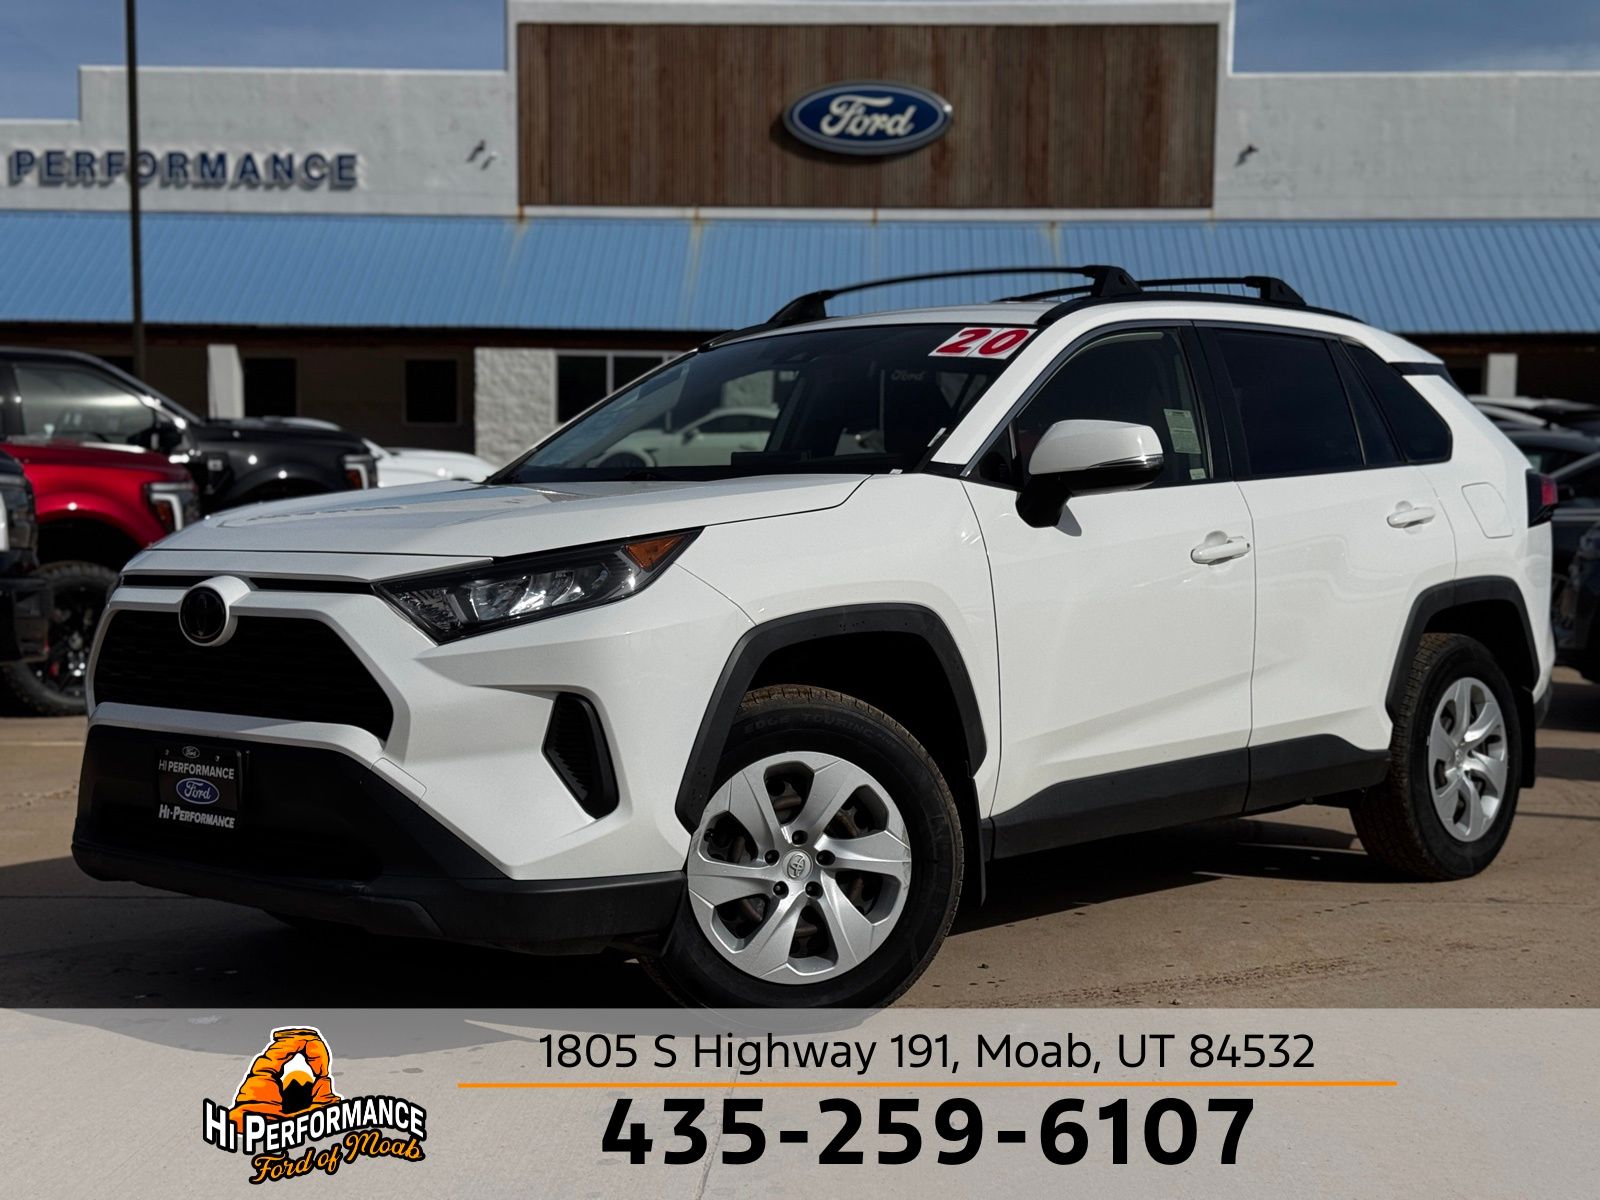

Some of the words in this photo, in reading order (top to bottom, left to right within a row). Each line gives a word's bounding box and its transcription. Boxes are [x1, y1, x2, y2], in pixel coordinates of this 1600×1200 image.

[820, 94, 917, 137] Ford
[11, 150, 358, 188] PERFORMANCE
[935, 328, 1030, 356] 20
[743, 714, 791, 734] EDGE
[801, 712, 873, 738] TOURING
[168, 761, 234, 779] PERFORMANCE
[183, 780, 212, 800] Ford
